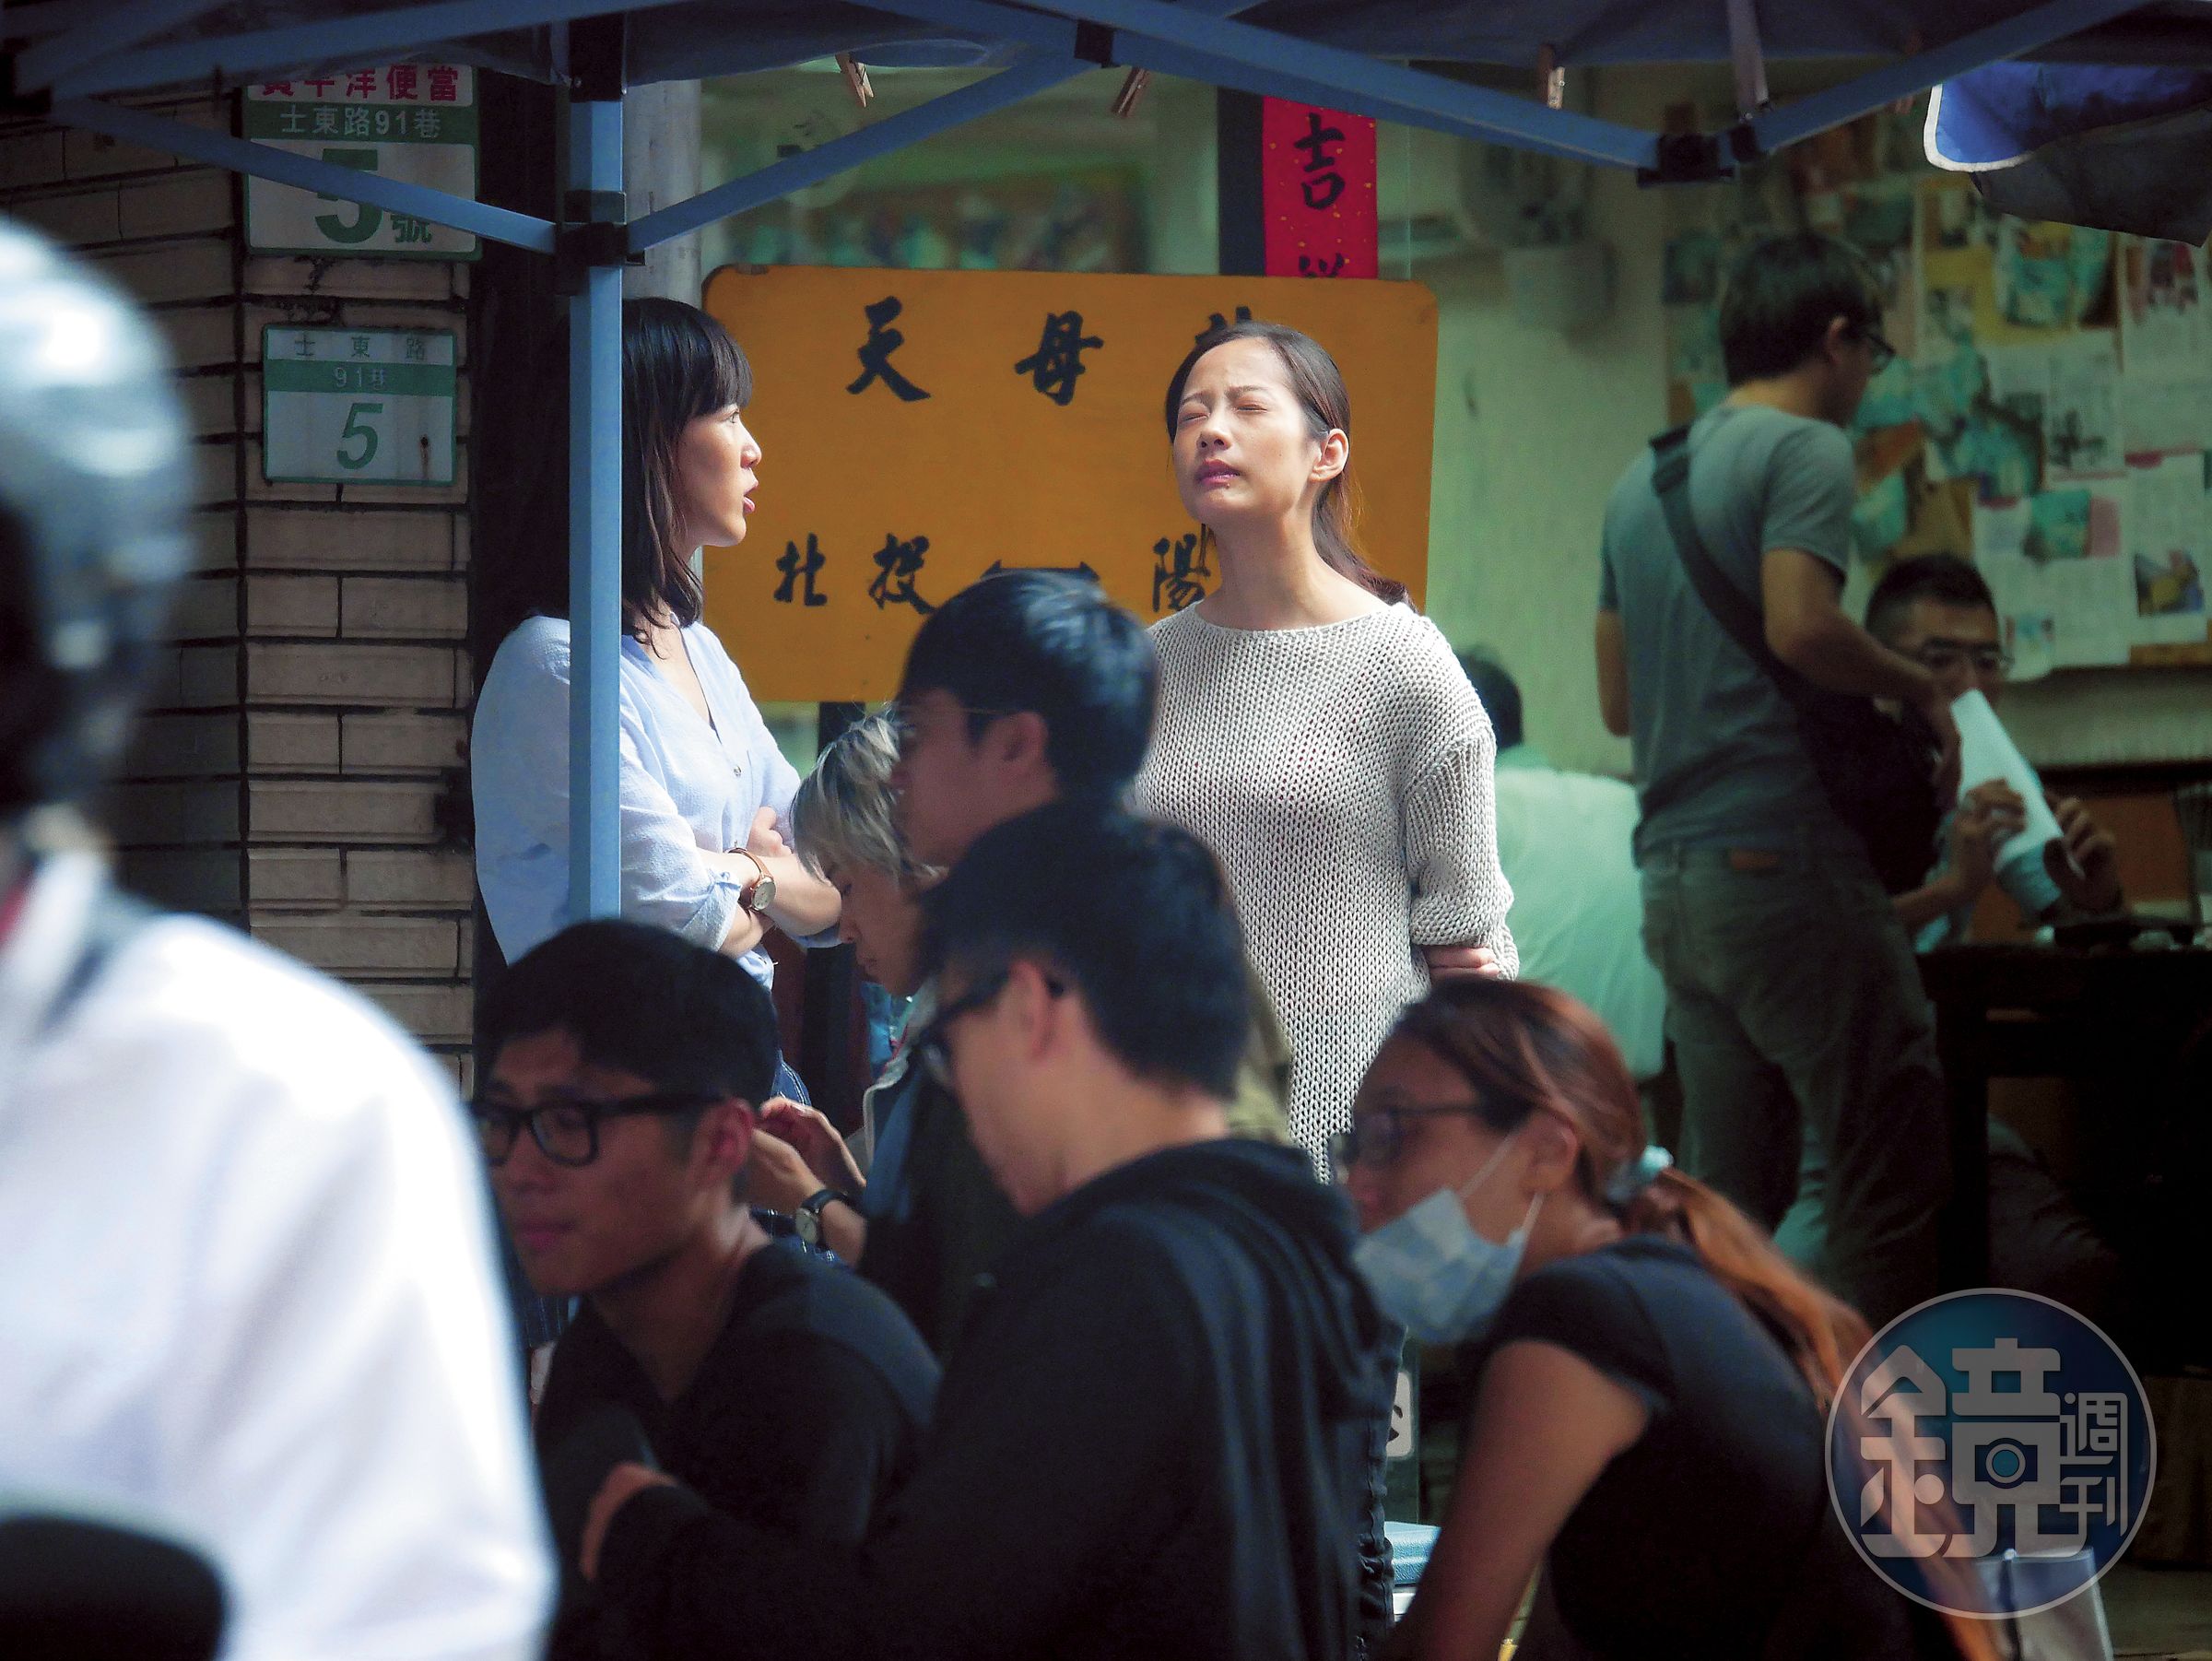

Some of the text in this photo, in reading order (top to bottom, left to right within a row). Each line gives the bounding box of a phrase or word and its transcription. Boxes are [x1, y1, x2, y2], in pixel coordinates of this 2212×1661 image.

[263, 65, 459, 101] 洋便當
[279, 104, 441, 138] 士東路91巷
[294, 335, 426, 360] 士東路
[336, 402, 383, 470] 5
[773, 532, 938, 615] 北投
